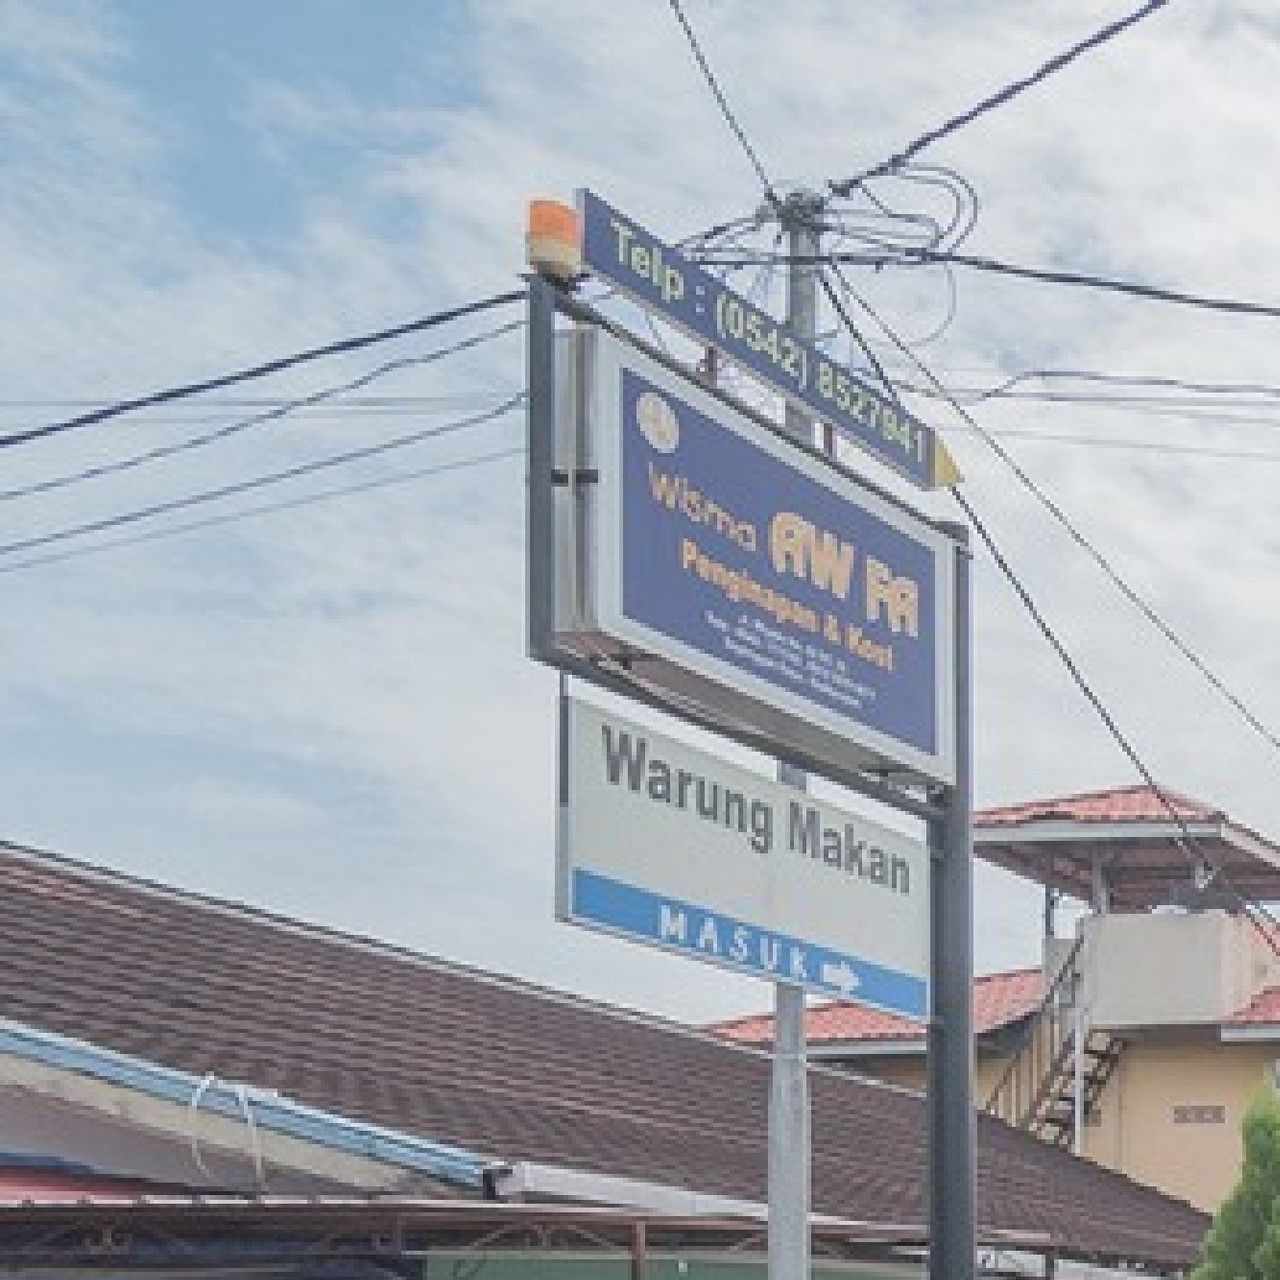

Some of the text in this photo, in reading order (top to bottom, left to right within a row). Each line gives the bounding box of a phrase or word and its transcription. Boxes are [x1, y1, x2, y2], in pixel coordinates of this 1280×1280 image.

[611, 220, 685, 302] Telp
[716, 292, 809, 391] (0542)
[816, 364, 925, 462] 8527941
[601, 724, 911, 894] Warung Makan
[660, 904, 809, 980] MASUK
